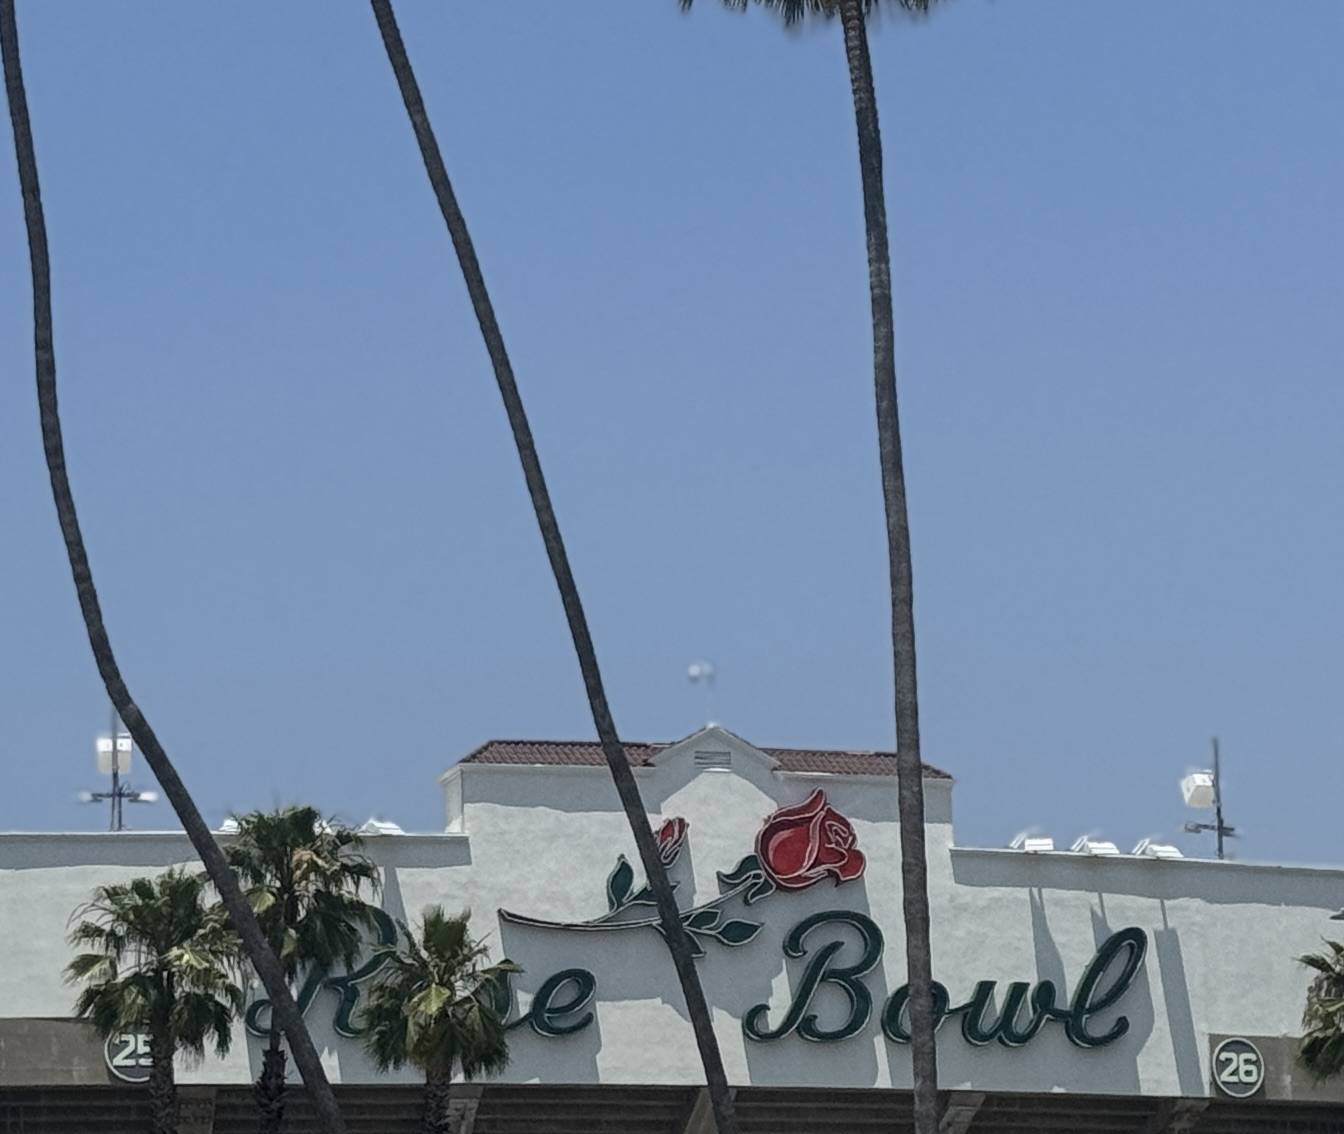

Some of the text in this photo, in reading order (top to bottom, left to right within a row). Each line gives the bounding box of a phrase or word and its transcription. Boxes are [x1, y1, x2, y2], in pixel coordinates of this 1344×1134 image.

[741, 909, 1148, 1048] Bowl
[112, 1033, 154, 1066] 25
[1218, 1051, 1258, 1083] 26
